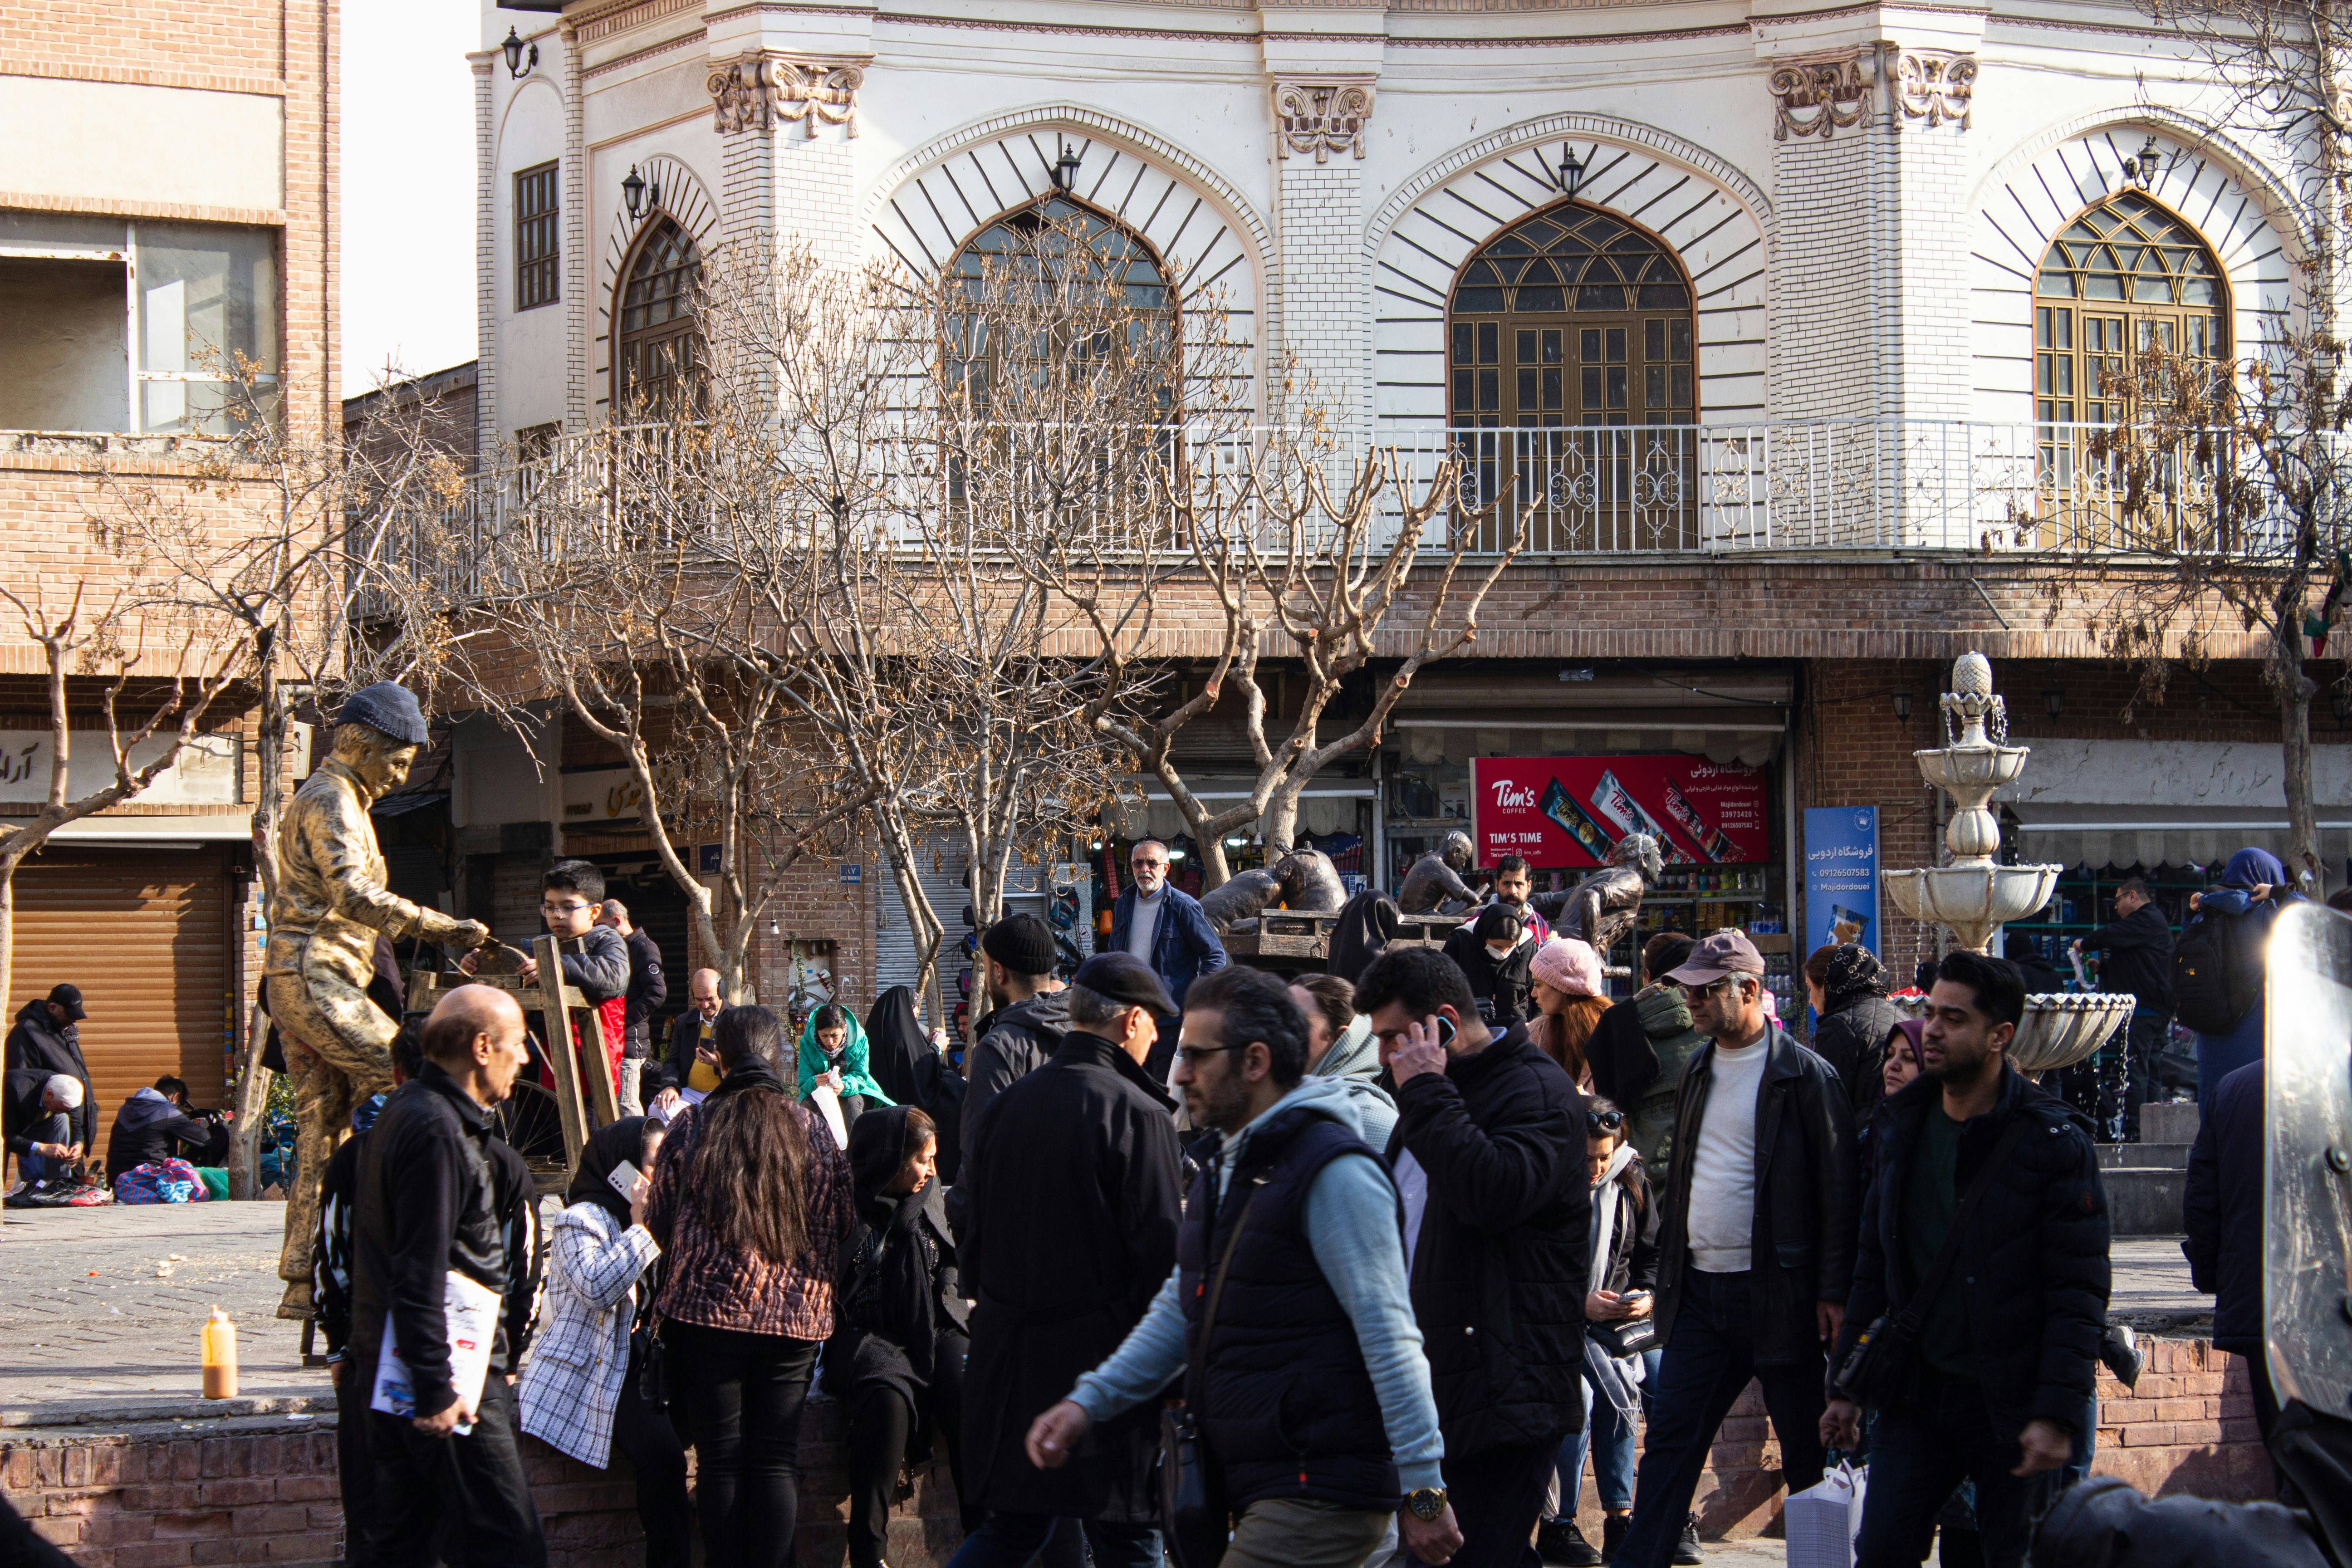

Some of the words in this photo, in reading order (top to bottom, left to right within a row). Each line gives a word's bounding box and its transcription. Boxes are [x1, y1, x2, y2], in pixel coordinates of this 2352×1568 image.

[1492, 780, 1535, 807] Tim's
[1610, 789, 1634, 822] Tim's
[1666, 788, 1690, 822] Tim's
[1490, 833, 1516, 843] TIM'S
[1519, 833, 1542, 843] TIME
[1808, 847, 1837, 861] اردویی
[1838, 843, 1873, 859] فروشگاه
[1820, 868, 1869, 877] 09126507583
[1821, 882, 1870, 892] Majidordouei
